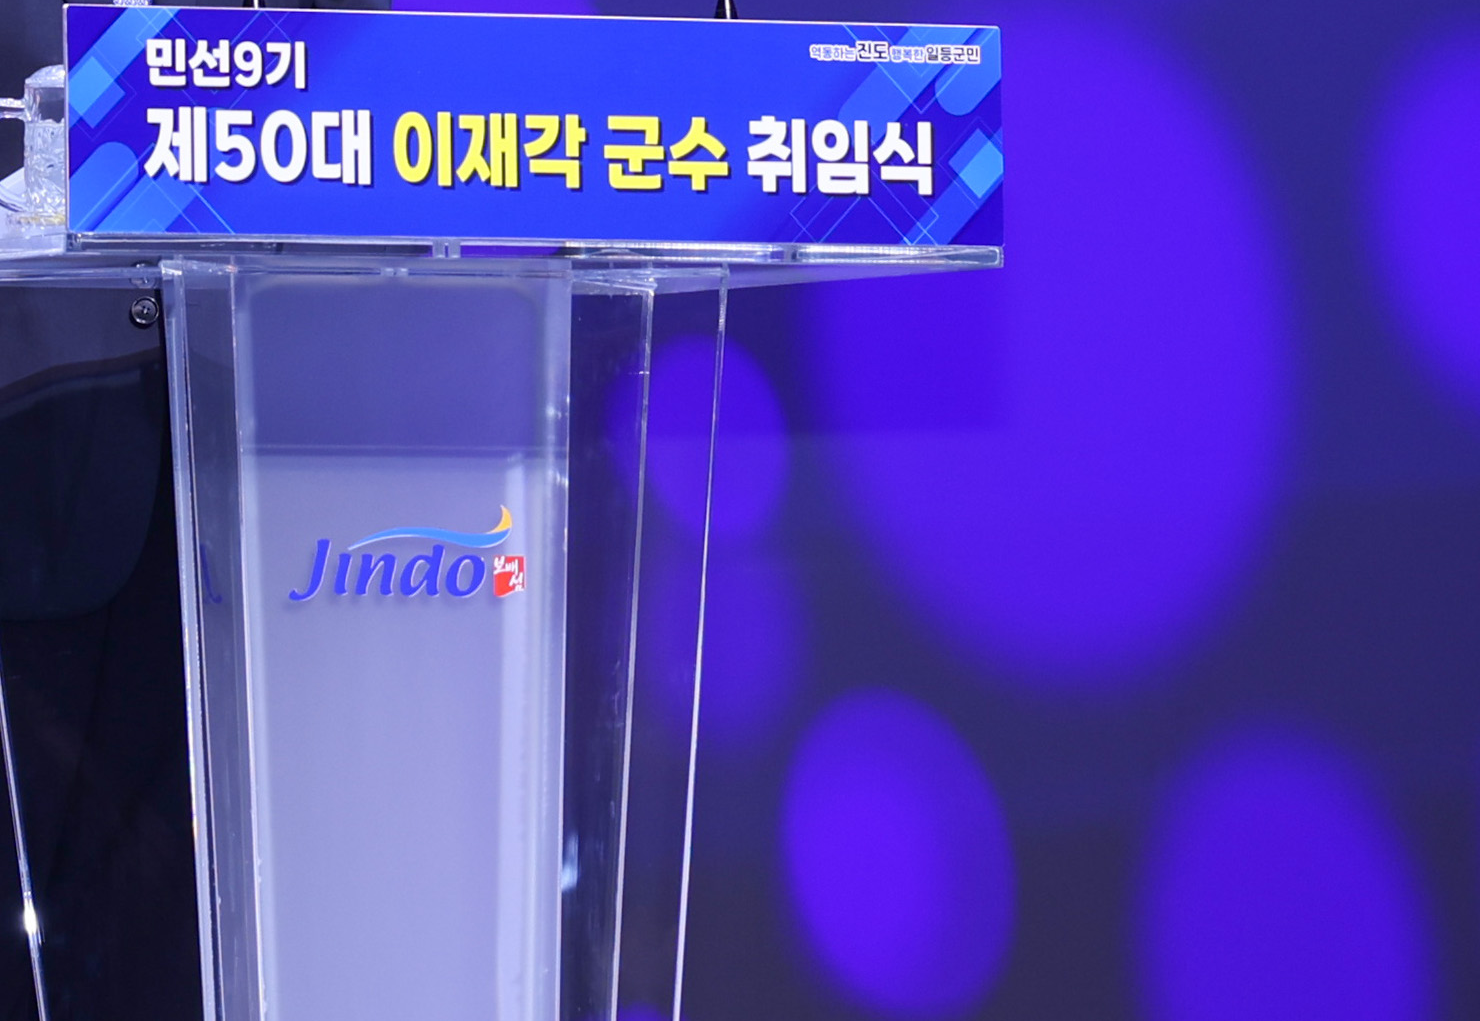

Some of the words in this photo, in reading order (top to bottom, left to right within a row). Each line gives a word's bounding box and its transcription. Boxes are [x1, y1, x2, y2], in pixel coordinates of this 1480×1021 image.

[146, 38, 306, 89] 민선9기
[857, 42, 888, 60] 진도
[891, 47, 924, 61] 행복한
[926, 45, 980, 62] 일등군민
[143, 106, 371, 185] 제50대
[393, 111, 586, 189] 이재각
[604, 115, 729, 191] 군수
[746, 115, 932, 195] 취임식
[288, 538, 486, 601] Jindo
